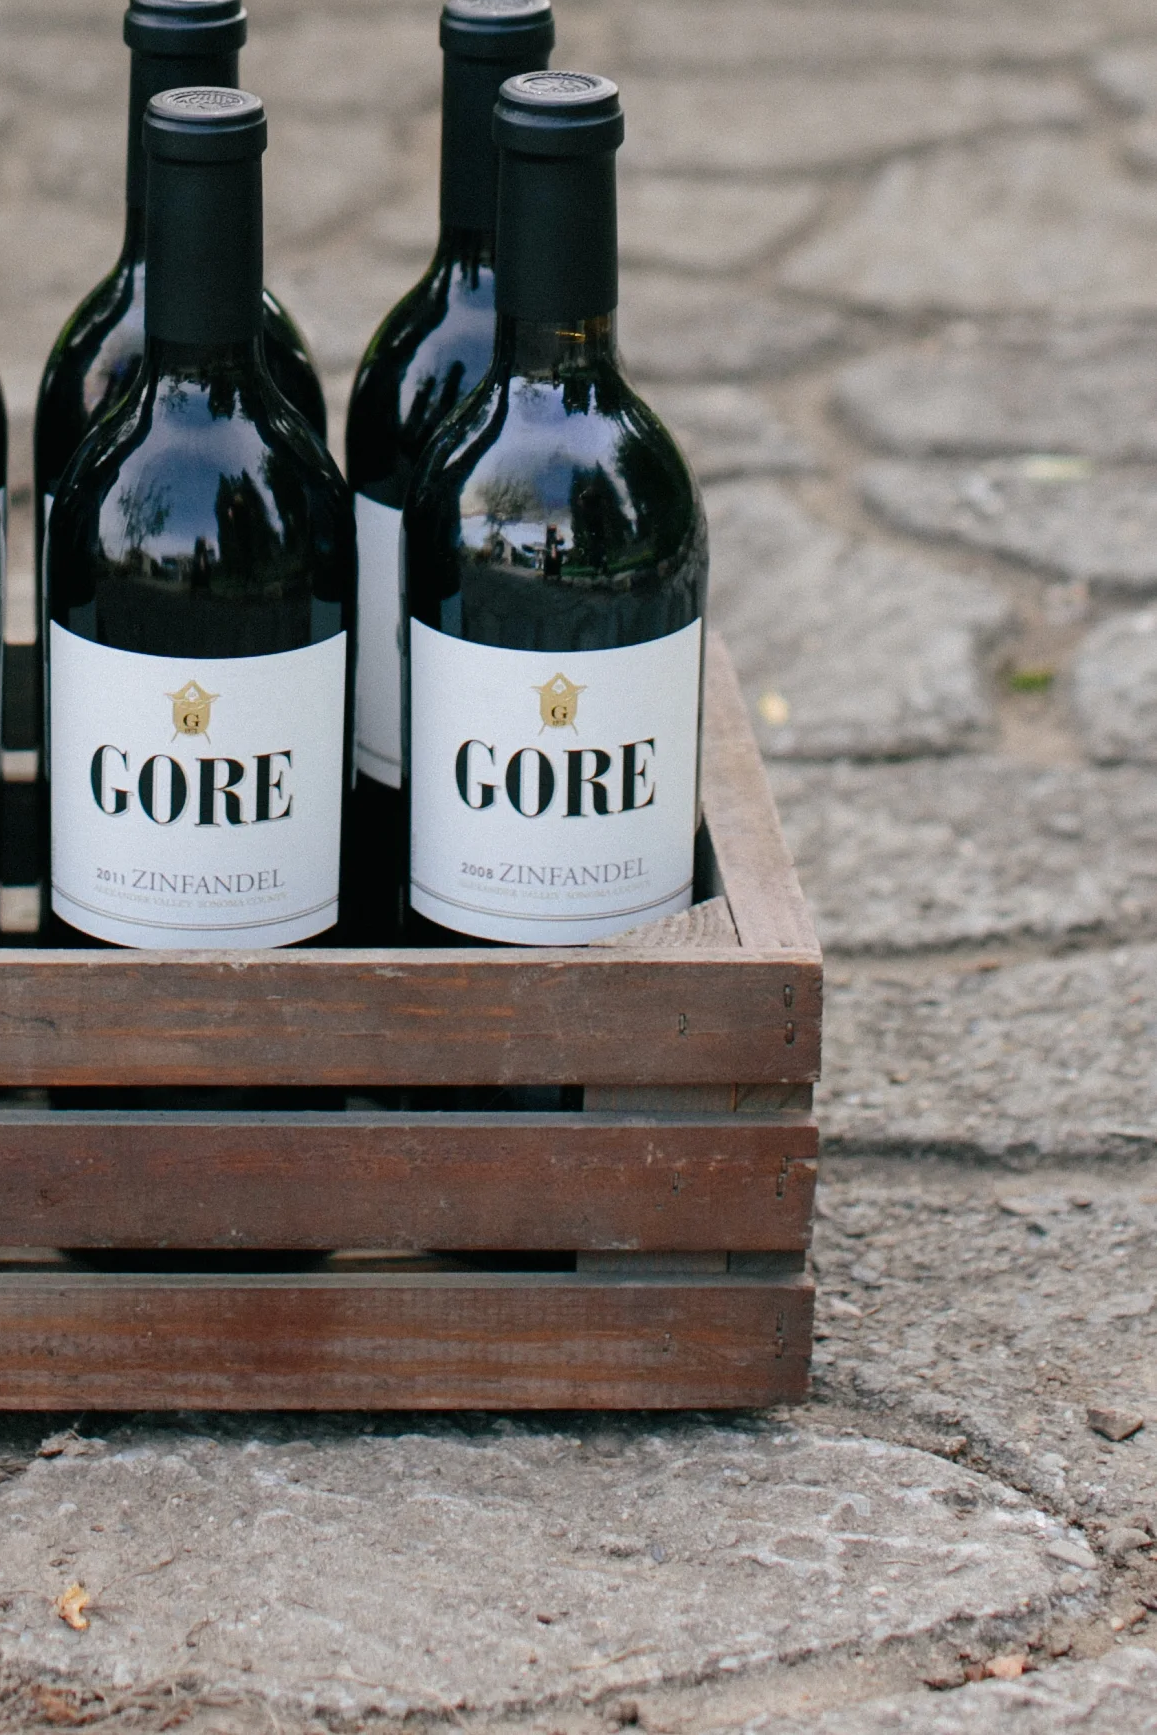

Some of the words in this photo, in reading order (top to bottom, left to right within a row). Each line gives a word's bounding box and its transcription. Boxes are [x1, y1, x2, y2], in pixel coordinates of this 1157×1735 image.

[183, 713, 200, 727] G
[551, 705, 568, 719] G
[90, 744, 293, 827] GORE
[455, 737, 656, 819] GORE
[96, 867, 126, 885] 2011
[132, 868, 285, 895] ZINFANDEL
[461, 862, 493, 880] 2008
[498, 857, 649, 886] ZINFANDEL
